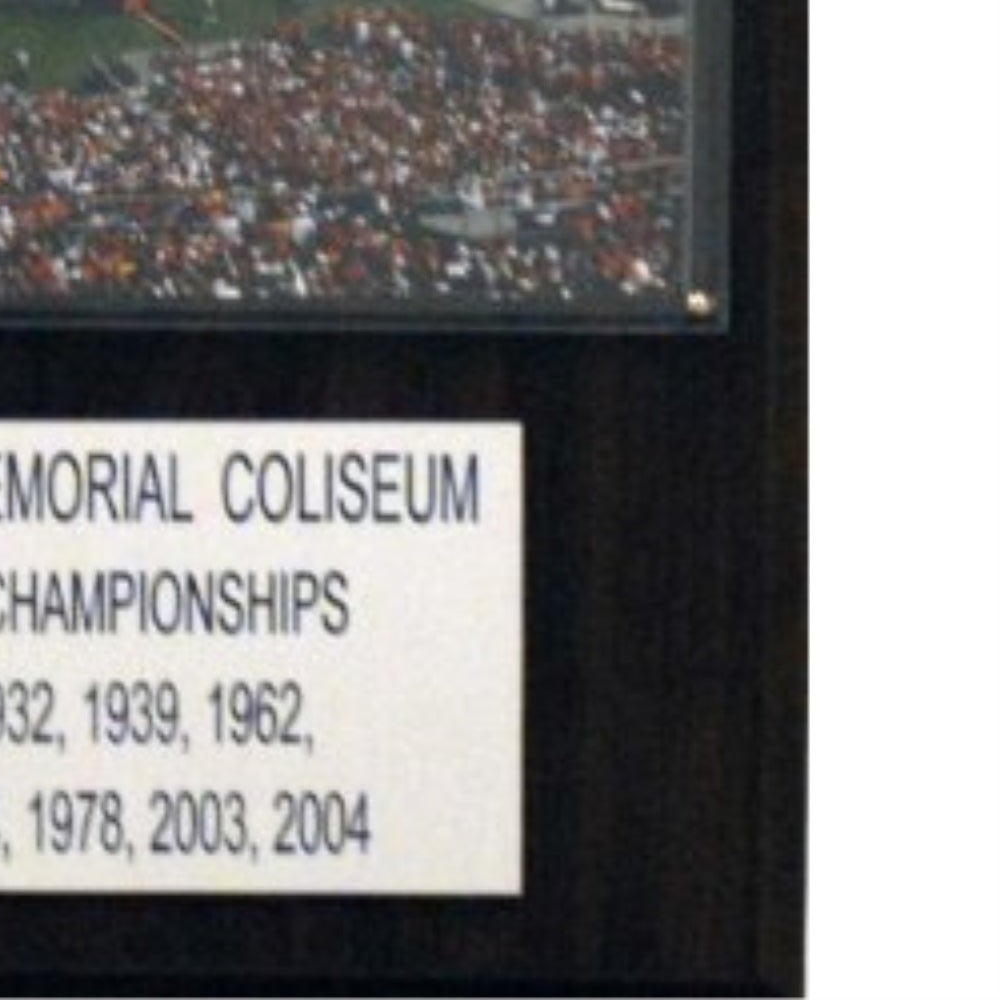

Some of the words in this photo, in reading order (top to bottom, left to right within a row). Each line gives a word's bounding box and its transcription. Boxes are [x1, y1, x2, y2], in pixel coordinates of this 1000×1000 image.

[221, 452, 479, 524] COLISEUM
[84, 682, 190, 751] 1939,
[209, 681, 314, 750] 1962,
[29, 791, 134, 858] 1978,
[149, 790, 259, 858] 2003,
[272, 790, 372, 855] 2004
